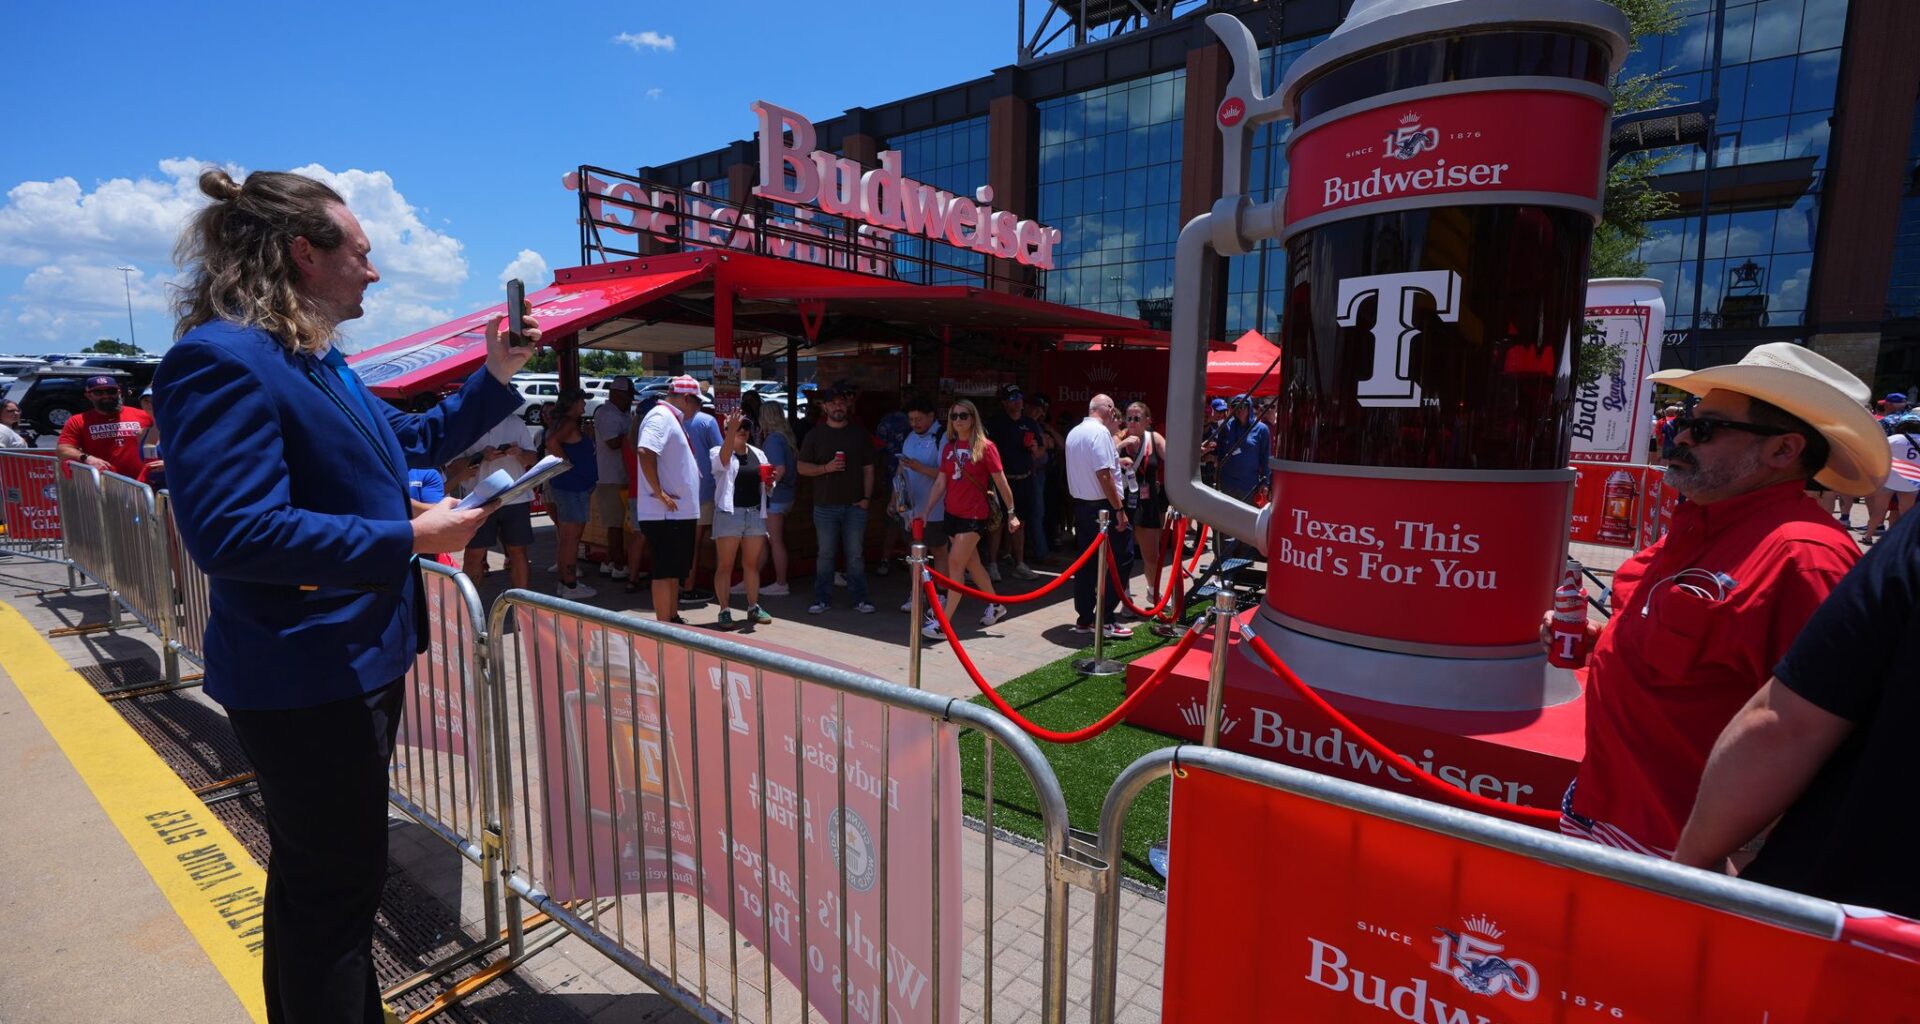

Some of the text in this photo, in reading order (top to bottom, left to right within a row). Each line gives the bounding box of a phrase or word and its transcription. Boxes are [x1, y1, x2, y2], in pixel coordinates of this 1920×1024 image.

[1345, 125, 1482, 160] SINCE 150 1876
[751, 100, 1060, 270] Budweiser
[1322, 159, 1509, 207] Budweiser
[1336, 269, 1462, 408] T
[91, 422, 139, 433] RANGERS
[91, 431, 132, 440] BASEBALL
[1291, 508, 1480, 554] Texas, This
[1280, 538, 1498, 590] Bud's For You
[1555, 630, 1582, 659] T
[145, 809, 207, 845] STEP
[176, 843, 242, 891] YOUR
[1356, 921, 1624, 1019] SINCE 150 1876
